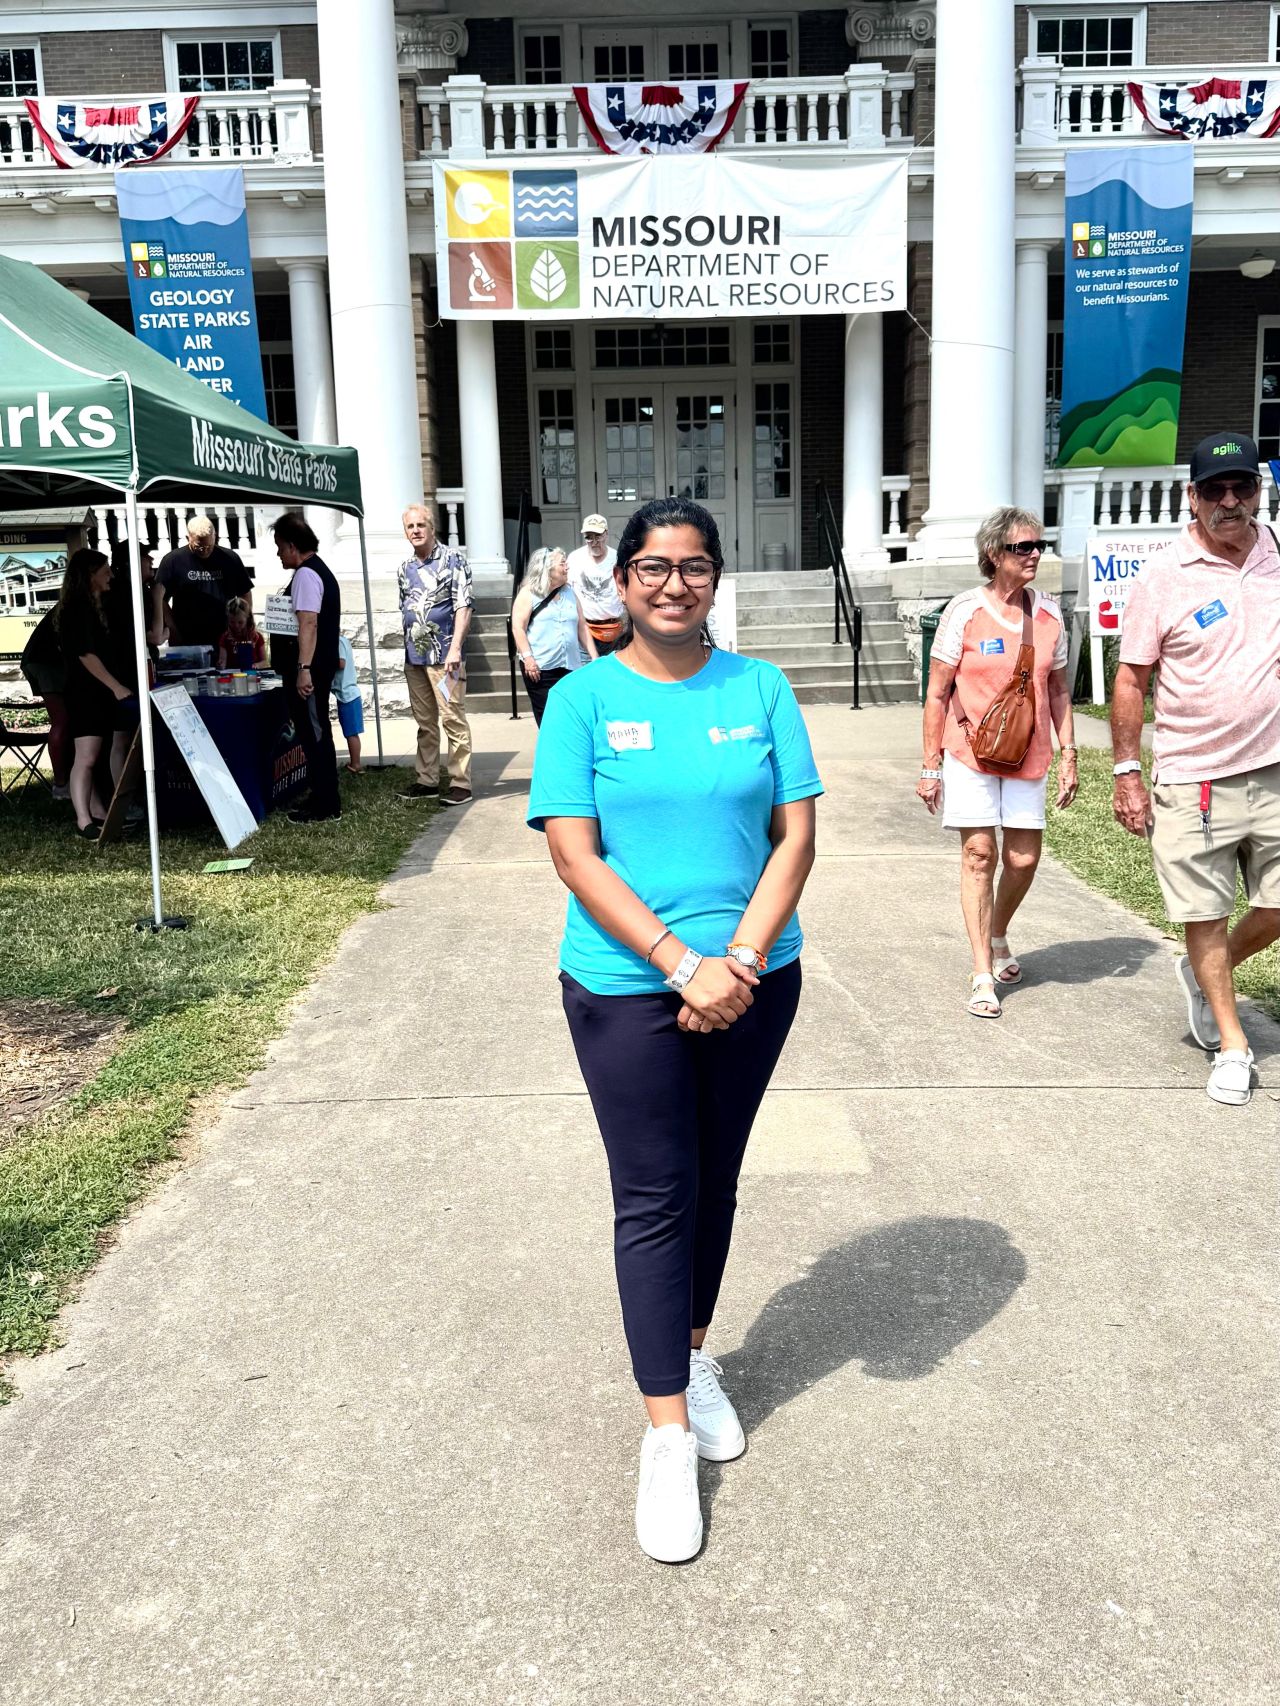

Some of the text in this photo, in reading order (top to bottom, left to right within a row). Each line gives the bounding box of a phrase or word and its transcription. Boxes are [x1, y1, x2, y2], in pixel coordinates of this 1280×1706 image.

[592, 215, 780, 247] MISSOURI
[1108, 230, 1156, 241] MISSOURI
[1108, 238, 1168, 249] DEPARTMENT OF
[1108, 245, 1184, 256] NATURAL RESOURCES
[168, 253, 215, 263] MISSOURI
[168, 262, 215, 271] DEPARTMENT
[592, 253, 828, 278] DEPARTMENT OF
[1076, 262, 1180, 279] We serve as stewards of
[169, 269, 245, 278] NATURAL RESOURCES
[1075, 278, 1178, 292] our natural resources to
[149, 289, 234, 306] GEOLOGY
[593, 280, 894, 308] NATURAL RESOURCES
[1083, 292, 1169, 306] benefit Missourians.
[139, 311, 251, 329] STATE PARKS
[183, 335, 213, 350] AIR
[200, 378, 233, 392] TER
[0, 392, 116, 448] rks
[191, 416, 338, 493] Missouri State Parks
[1213, 443, 1241, 455] agilix
[1106, 543, 1144, 553] STATE
